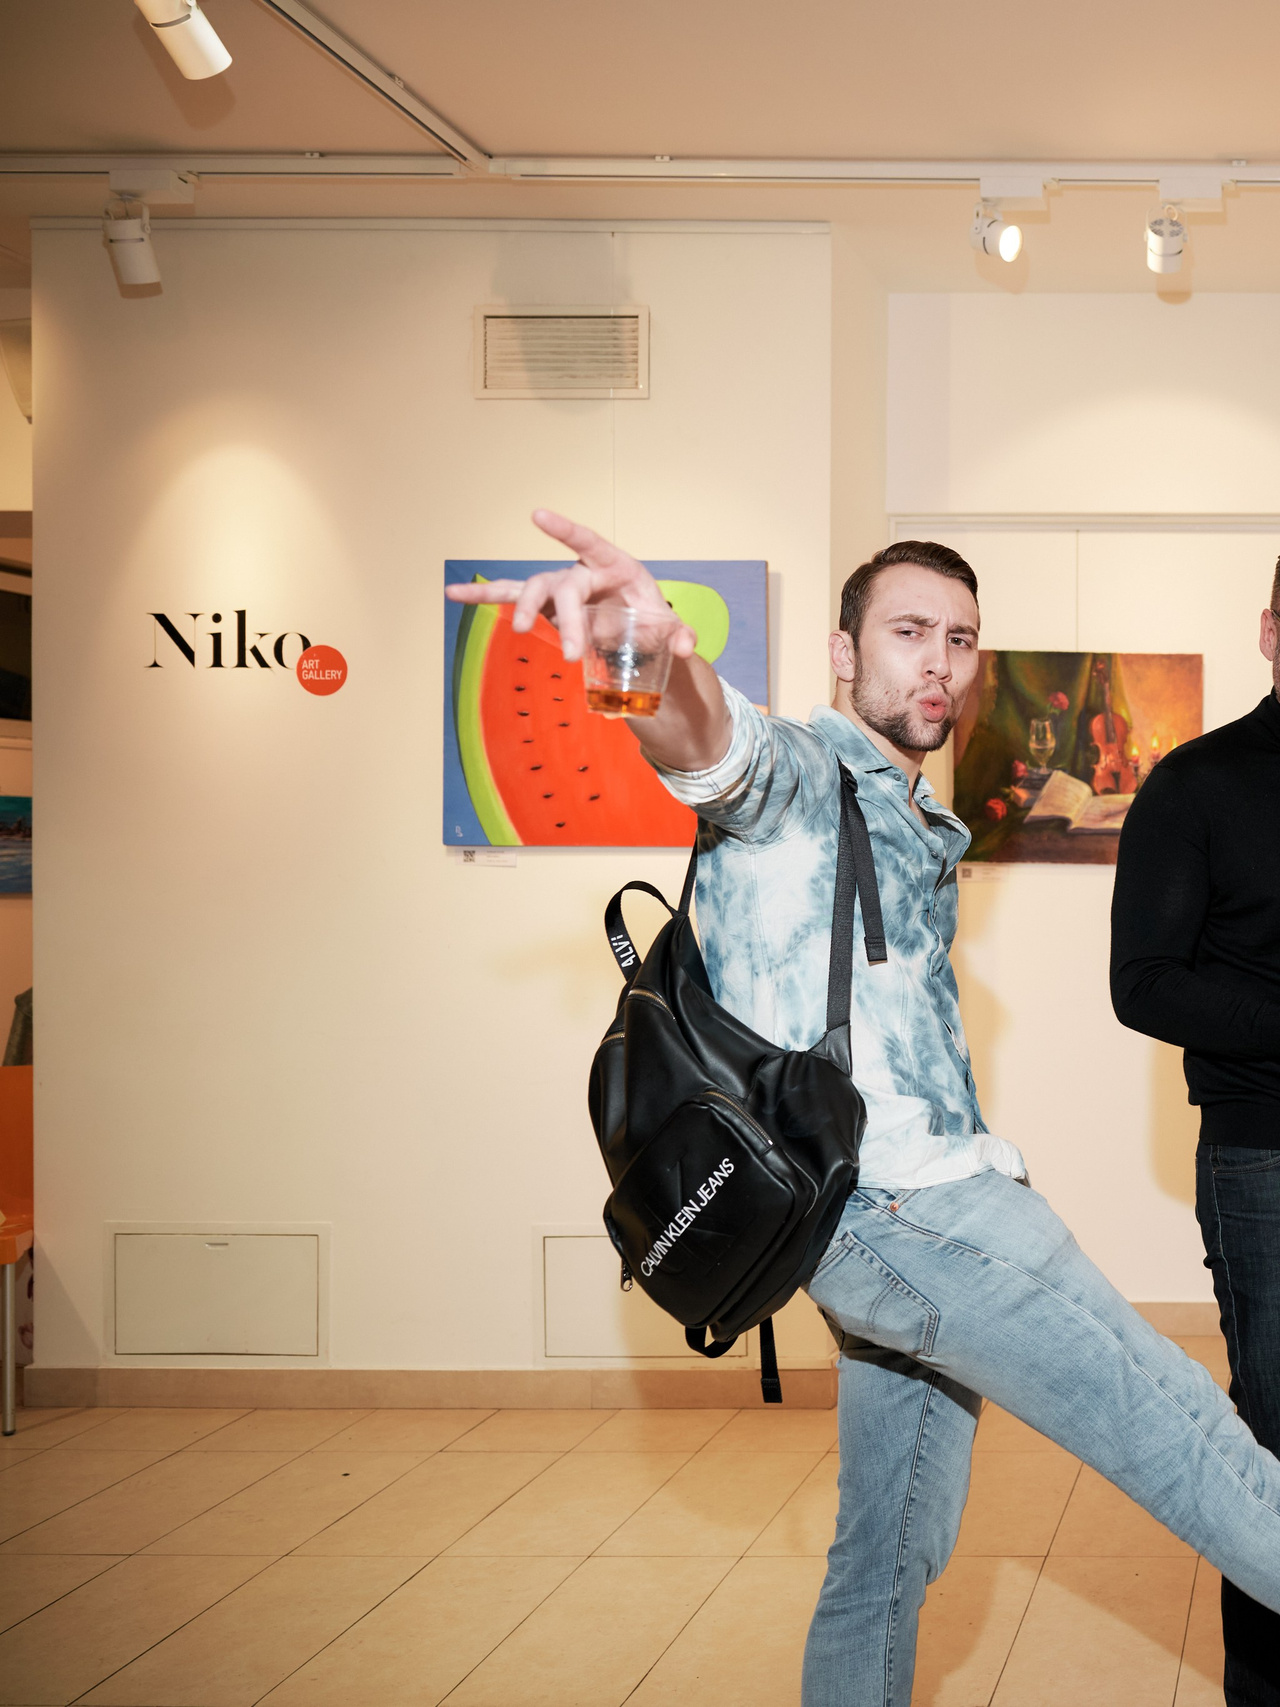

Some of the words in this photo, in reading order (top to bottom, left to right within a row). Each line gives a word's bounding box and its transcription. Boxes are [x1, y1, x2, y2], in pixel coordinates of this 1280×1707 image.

[145, 609, 311, 671] Niko
[301, 659, 320, 669] ART
[301, 669, 343, 681] GALLERY
[640, 1234, 673, 1277] CALVIN
[664, 1199, 702, 1242] KLEIN
[696, 1157, 735, 1207] JEANS
